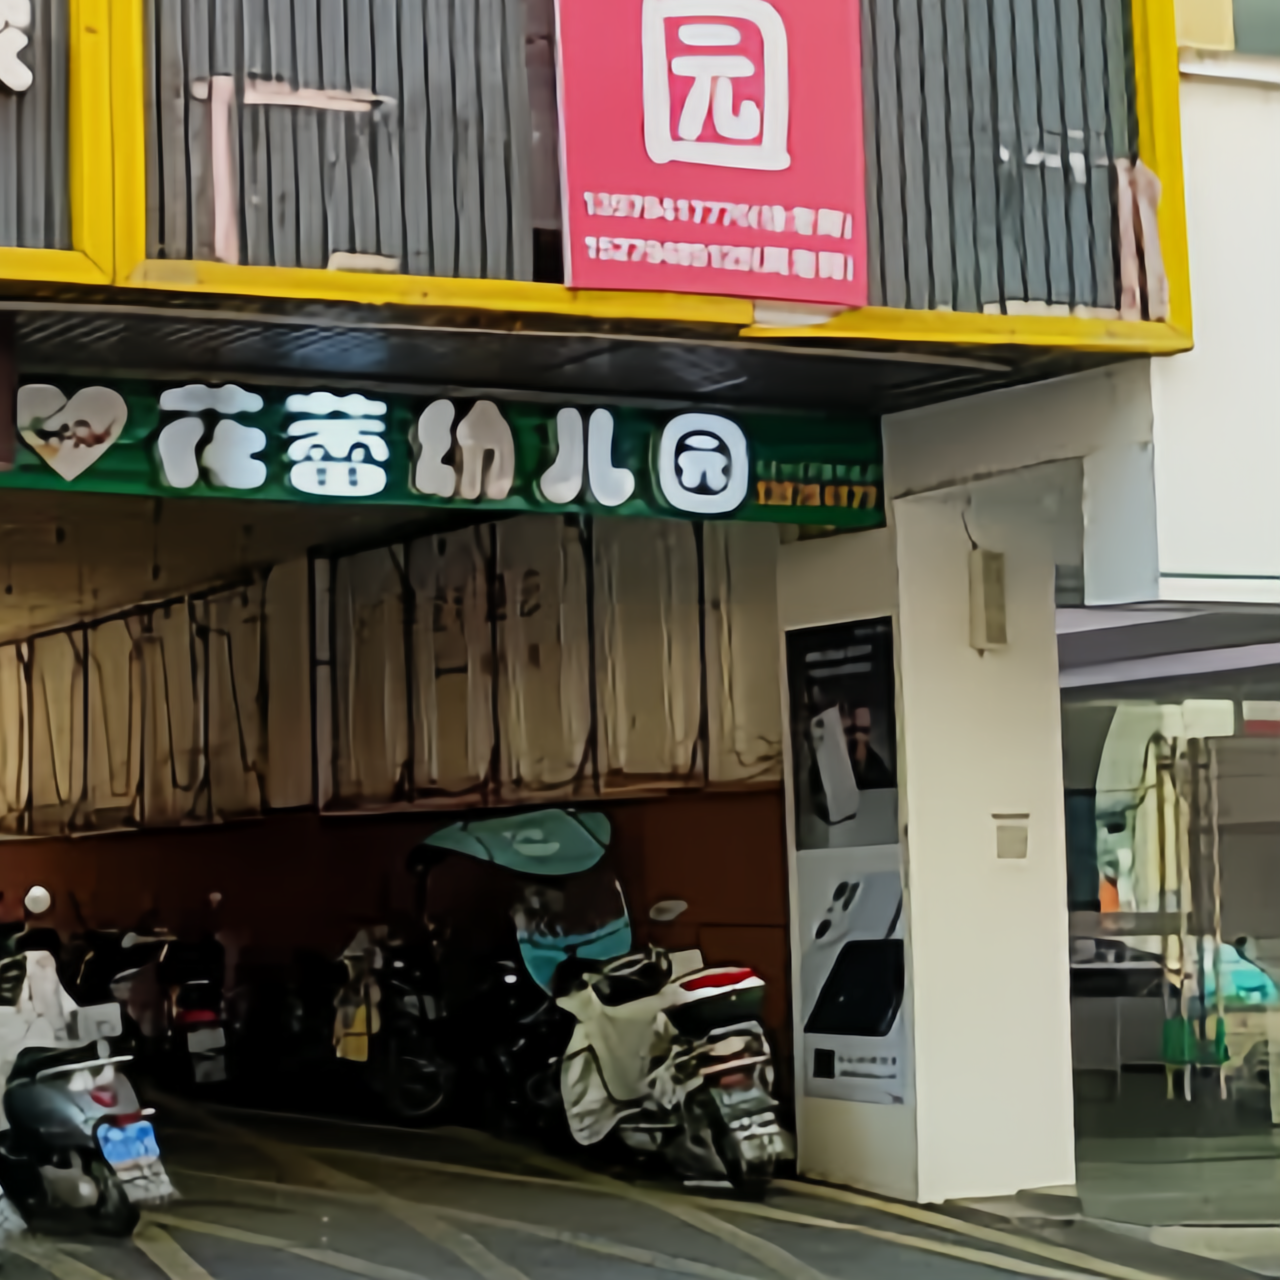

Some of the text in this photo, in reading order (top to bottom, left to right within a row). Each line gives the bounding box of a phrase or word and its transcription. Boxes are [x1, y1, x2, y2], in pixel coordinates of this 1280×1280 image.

[157, 383, 749, 514] 花蕾幼儿园
